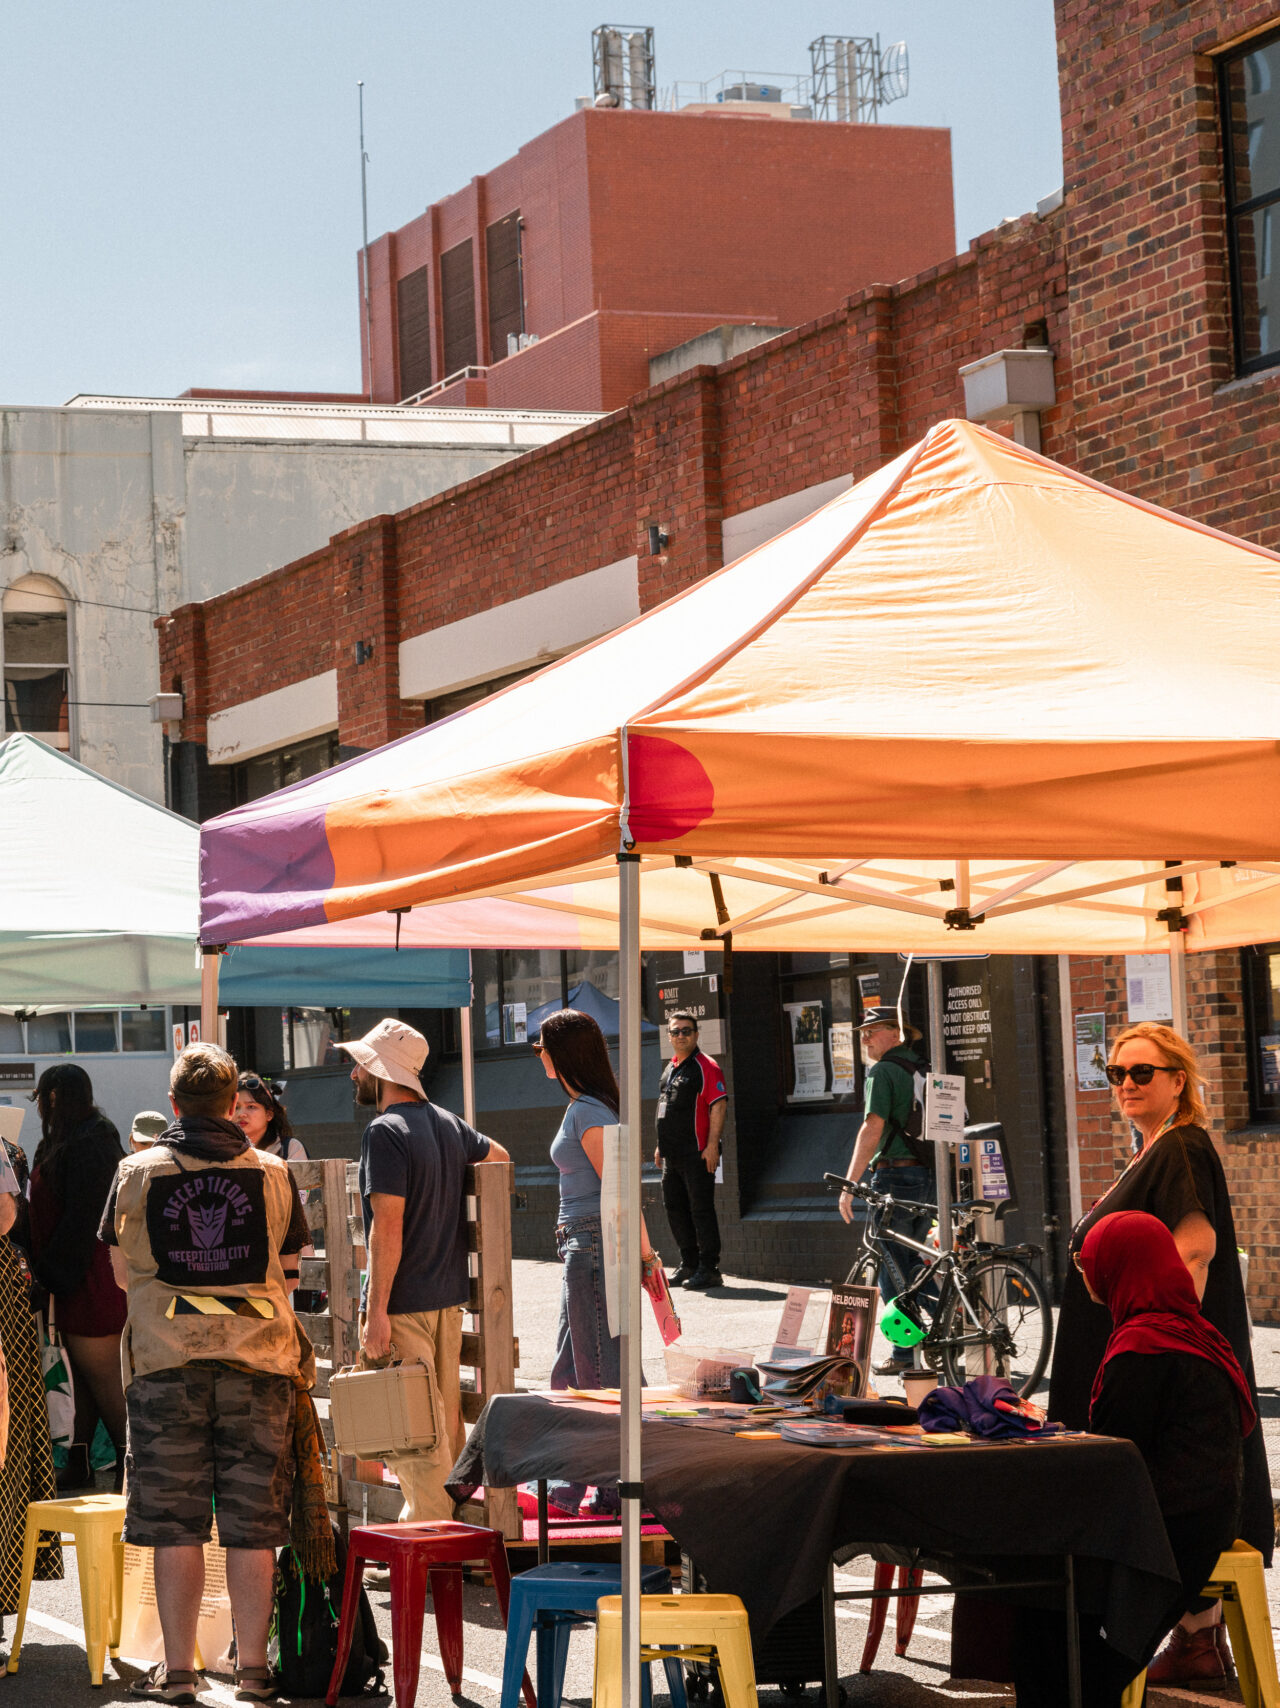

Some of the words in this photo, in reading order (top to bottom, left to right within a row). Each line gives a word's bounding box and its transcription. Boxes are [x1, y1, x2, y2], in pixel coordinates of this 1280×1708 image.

[948, 985, 982, 998] AUTHORISED
[947, 1000, 968, 1010] ACCESS
[950, 1013, 962, 1023] NOT
[962, 1010, 990, 1022] OBSTRUCT
[950, 1026, 962, 1036] NOT
[962, 1024, 976, 1035] KEEP
[976, 1023, 992, 1034] OPEN
[163, 1176, 253, 1219] DECEPTICONS
[168, 1248, 227, 1262] DECEPTICON
[228, 1245, 250, 1260] CITY
[187, 1261, 230, 1272] CYBERTRON
[831, 1294, 870, 1308] MELBOURNE
